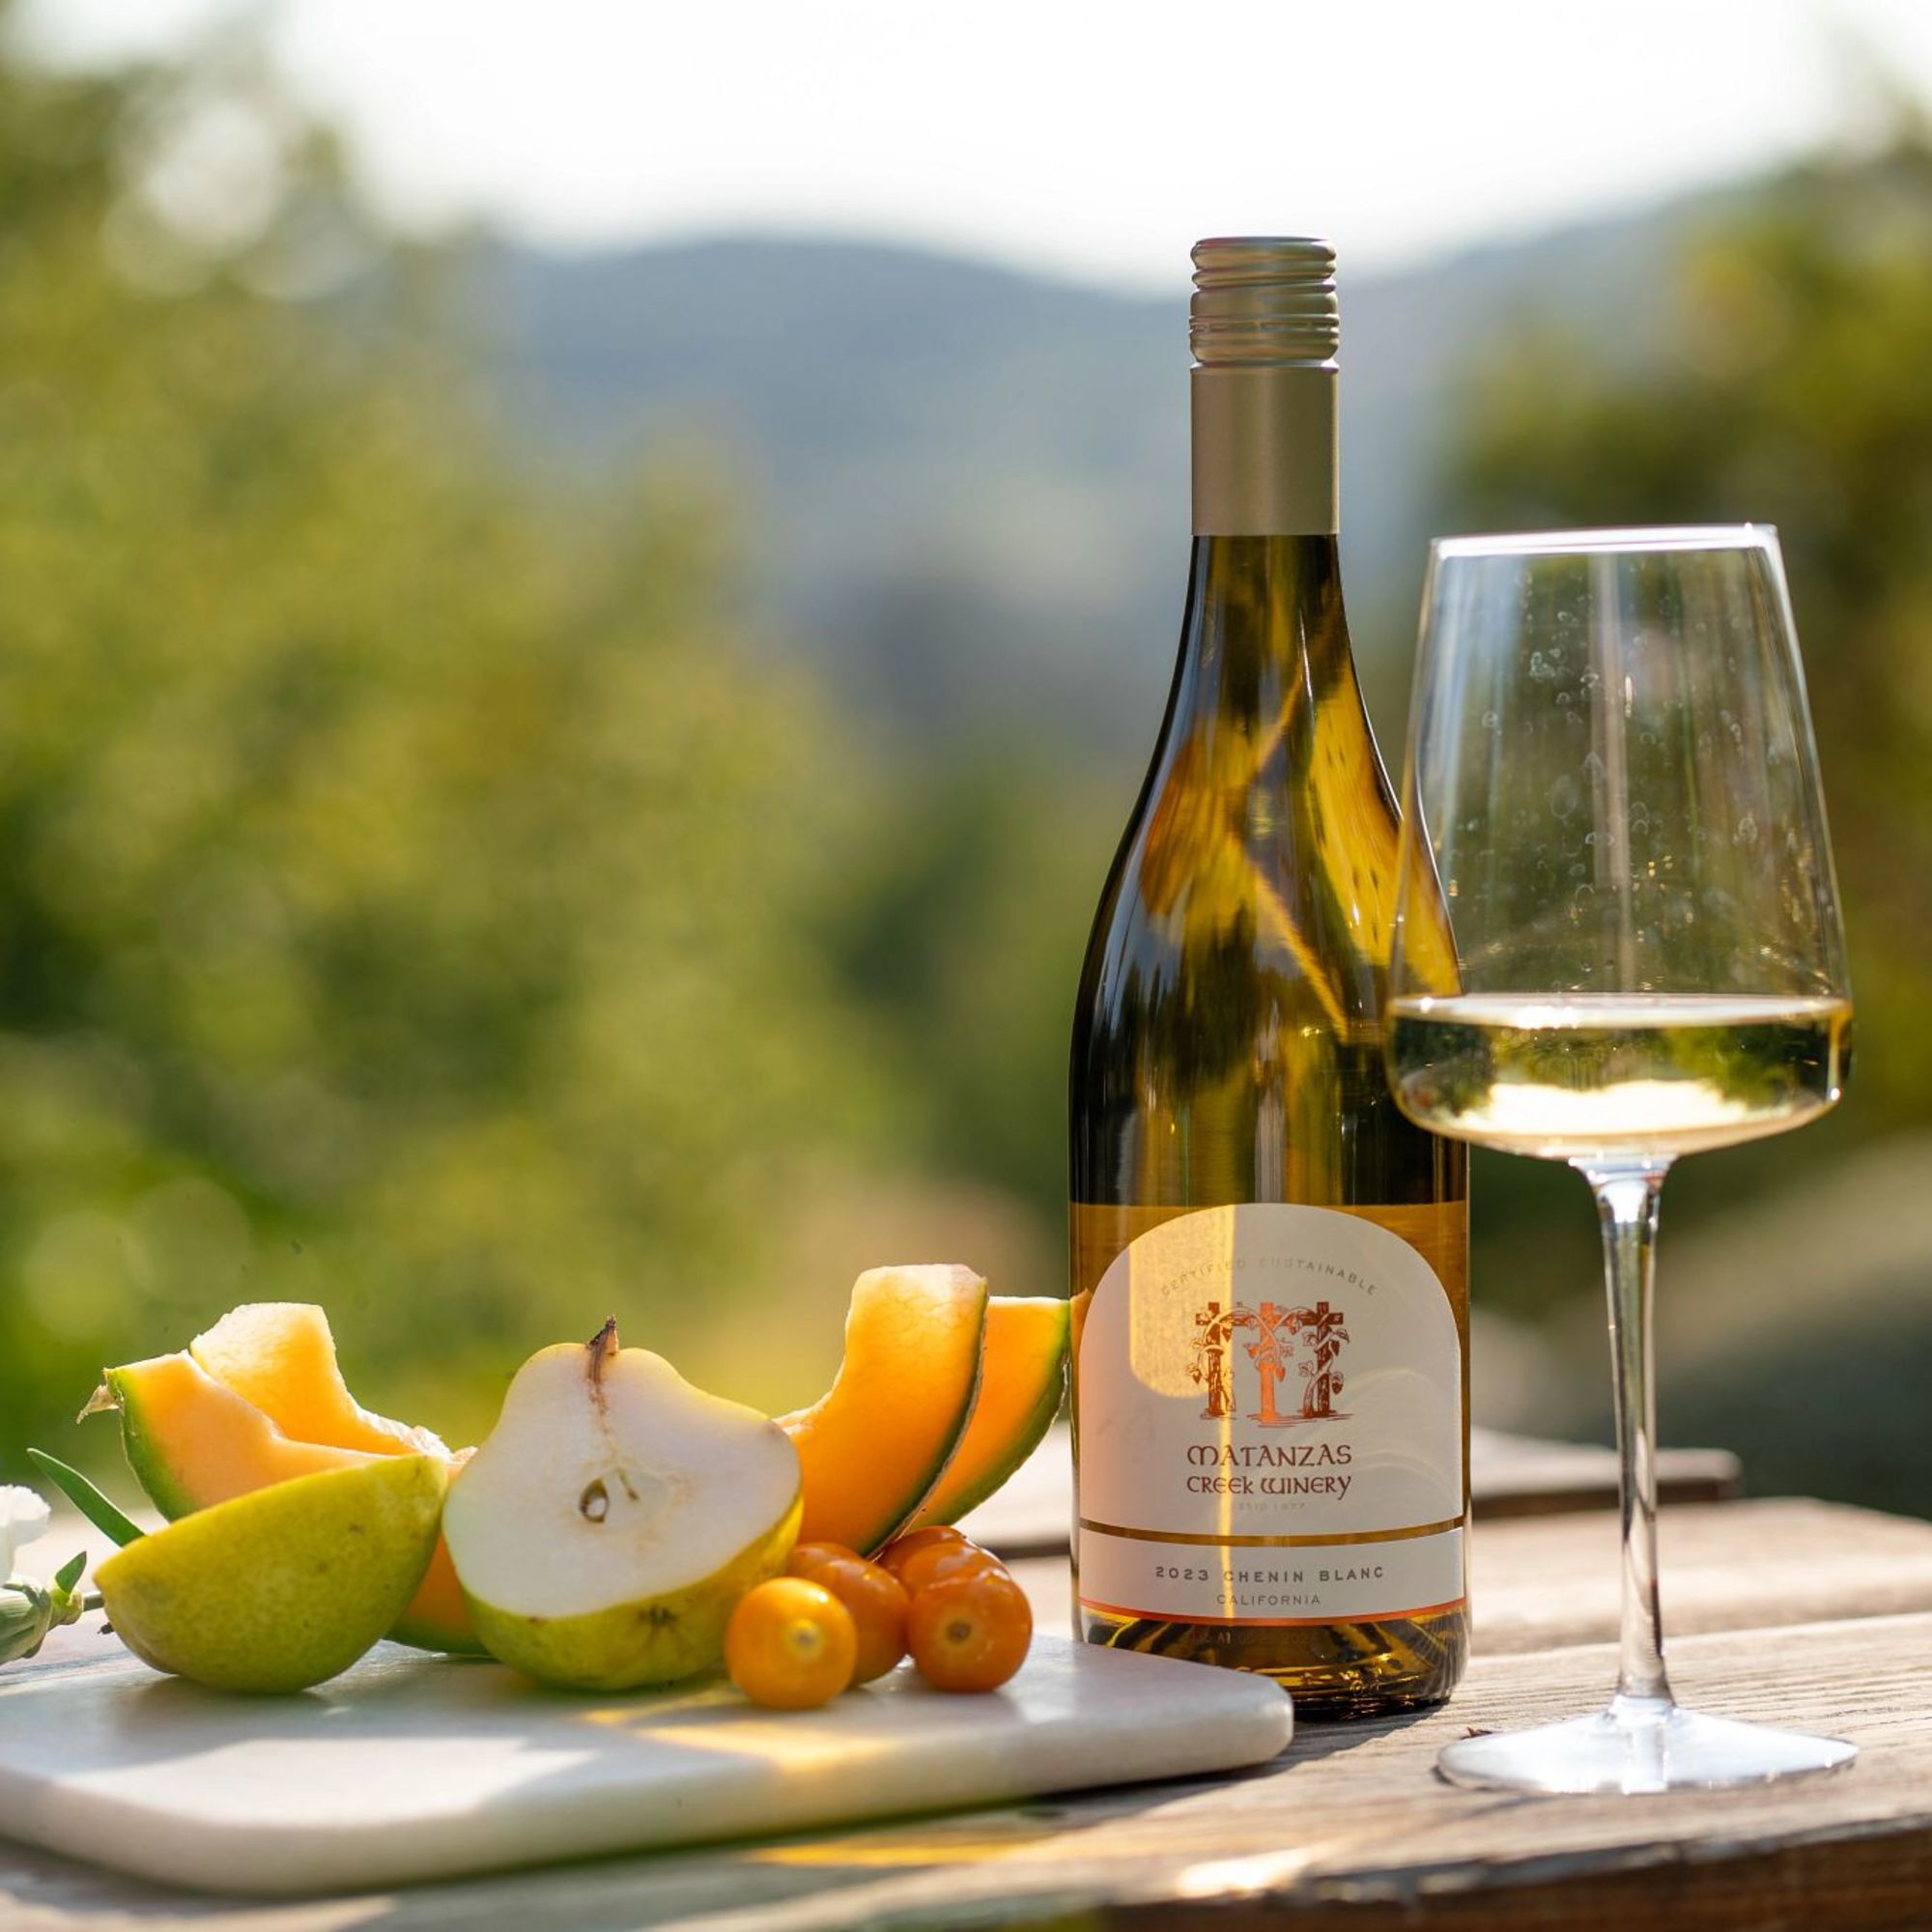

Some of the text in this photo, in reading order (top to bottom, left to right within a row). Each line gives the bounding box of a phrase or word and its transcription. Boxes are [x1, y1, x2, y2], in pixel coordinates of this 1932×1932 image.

[1259, 1258, 1378, 1296] SUSTAINABLE
[1187, 1444, 1352, 1467] MATANZAS
[1155, 1566, 1384, 1583] 2023 CHENIN BLANC
[1216, 1594, 1321, 1605] CALIFORNIA
